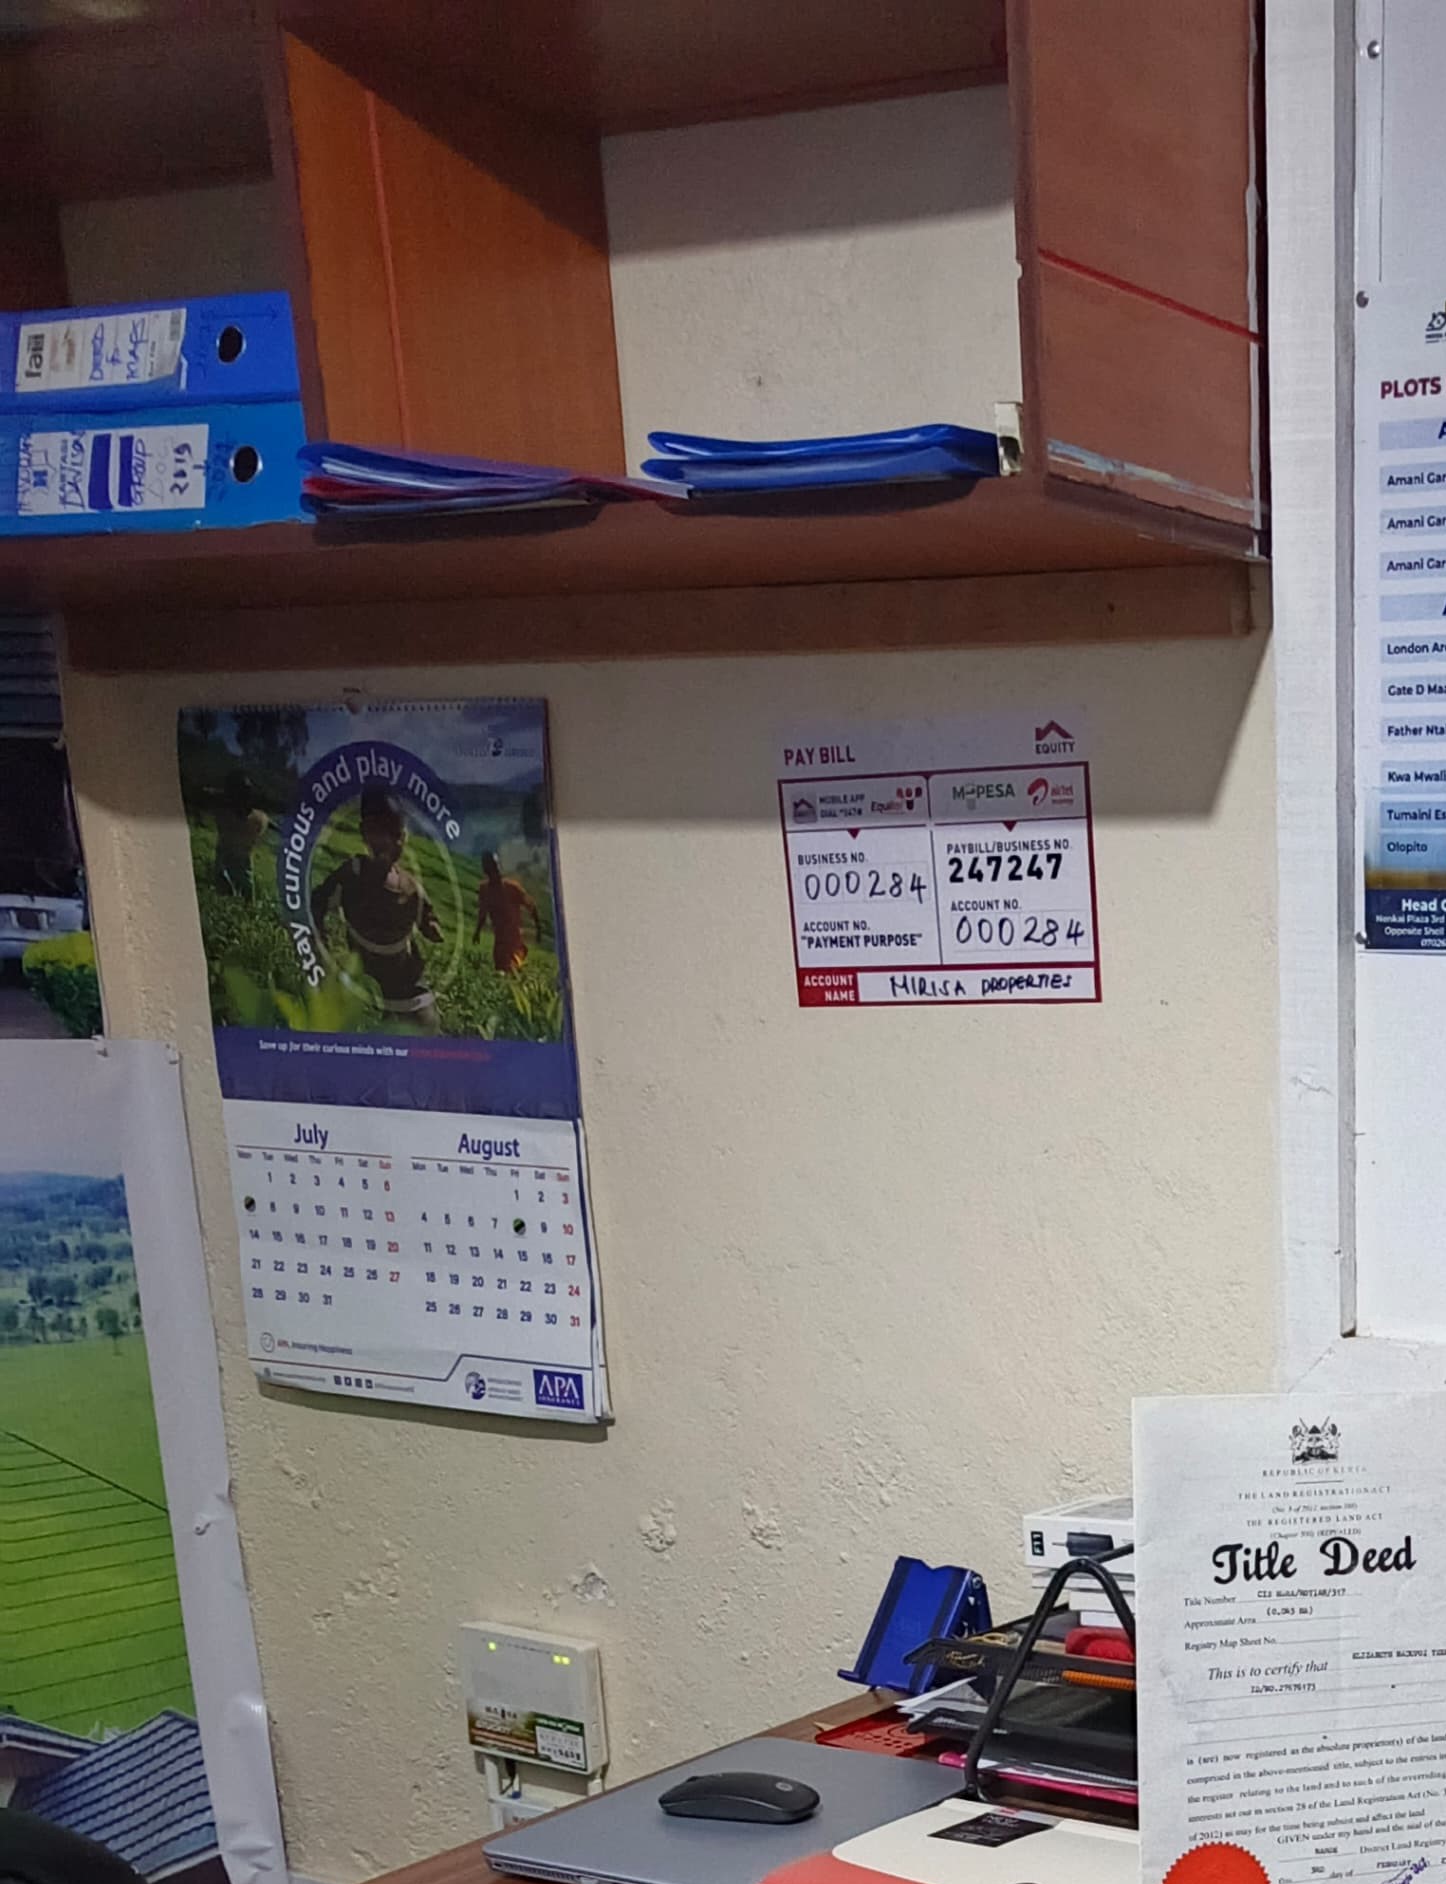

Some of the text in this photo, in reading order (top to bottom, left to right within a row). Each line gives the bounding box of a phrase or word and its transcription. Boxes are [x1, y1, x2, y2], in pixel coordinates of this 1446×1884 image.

[1381, 376, 1441, 399] PLOTS
[1387, 473, 1424, 487] Amani
[1388, 642, 1428, 655] London
[784, 745, 856, 766] PAY BILL
[1036, 742, 1075, 755] EQUITY
[1387, 809, 1432, 821] Tumaini
[284, 802, 315, 910] curious
[312, 754, 351, 803] and
[356, 749, 402, 785] play
[407, 772, 461, 840] more
[798, 853, 848, 865] BUSINESS
[948, 853, 1063, 883] 247247
[804, 870, 927, 904] 000284
[951, 900, 999, 912] ACCOUNT
[1401, 898, 1437, 913] Head
[956, 916, 1085, 947] 000284
[804, 975, 853, 987] ACCOUNT
[890, 974, 1072, 998] MIRISA PROPERTIES
[825, 990, 855, 1002] NAME
[293, 1123, 328, 1150] July
[458, 1133, 520, 1160] August
[538, 1374, 579, 1396] APA
[1212, 1536, 1417, 1585] Title Deed
[1208, 1660, 1328, 1681] This is to certify that
